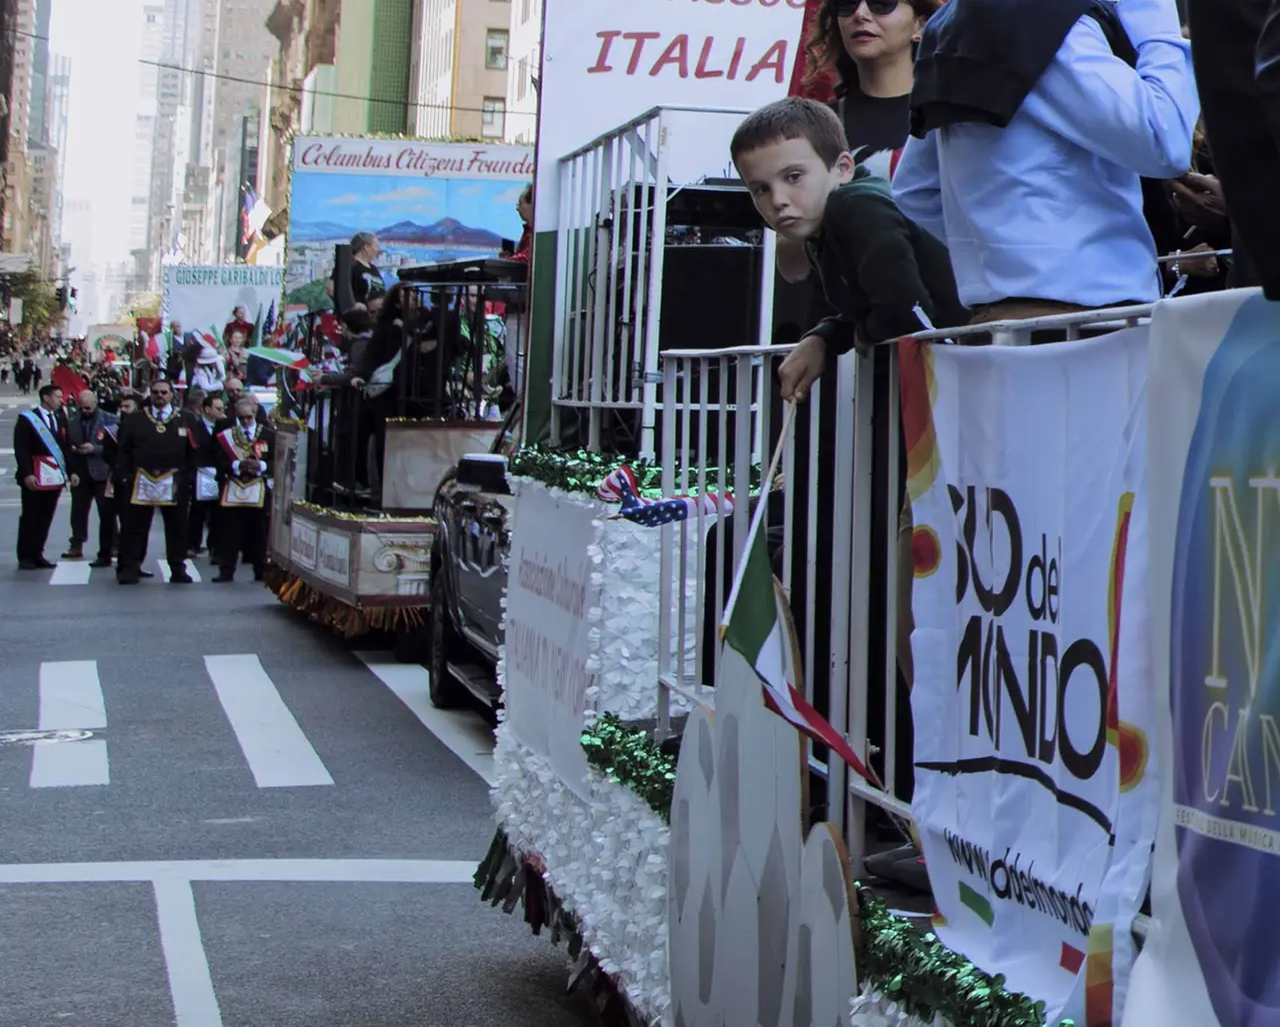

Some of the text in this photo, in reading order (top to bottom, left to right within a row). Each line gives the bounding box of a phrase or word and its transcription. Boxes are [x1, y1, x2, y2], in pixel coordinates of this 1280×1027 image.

[587, 30, 788, 84] ITALIA
[302, 143, 391, 168] Columbus
[396, 147, 463, 177] Citizens
[176, 269, 218, 286] GIUSEPPE
[221, 269, 268, 286] GARIBALDI
[1206, 819, 1235, 839] DELLA
[1239, 827, 1274, 849] MUSICA
